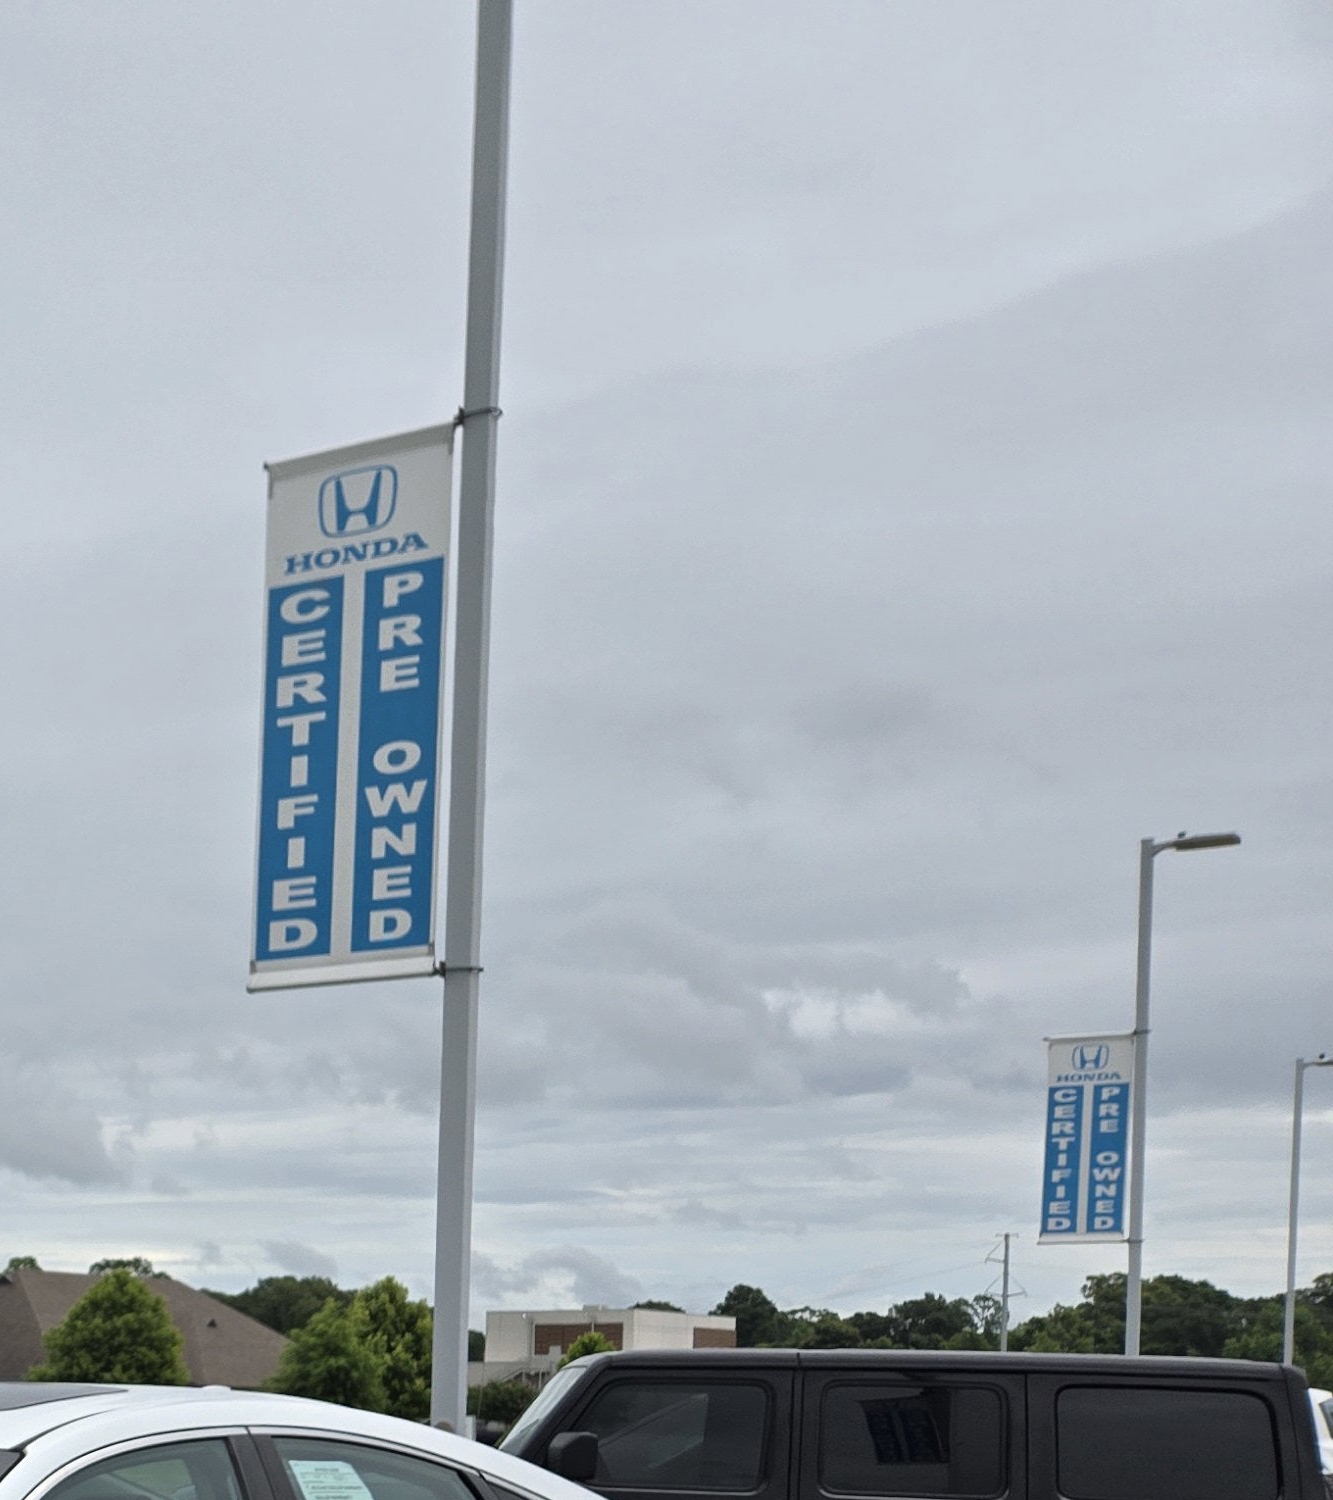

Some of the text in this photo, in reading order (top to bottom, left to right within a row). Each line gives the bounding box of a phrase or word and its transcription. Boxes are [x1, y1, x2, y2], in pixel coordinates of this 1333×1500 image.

[284, 531, 429, 575] HONDA
[268, 588, 332, 952] CERTIFIED
[364, 571, 428, 943] PRE OWNED
[1056, 1072, 1122, 1083] HONDA
[1047, 1088, 1078, 1231] CERTIFIED
[1093, 1086, 1121, 1230] PRE OWNED
